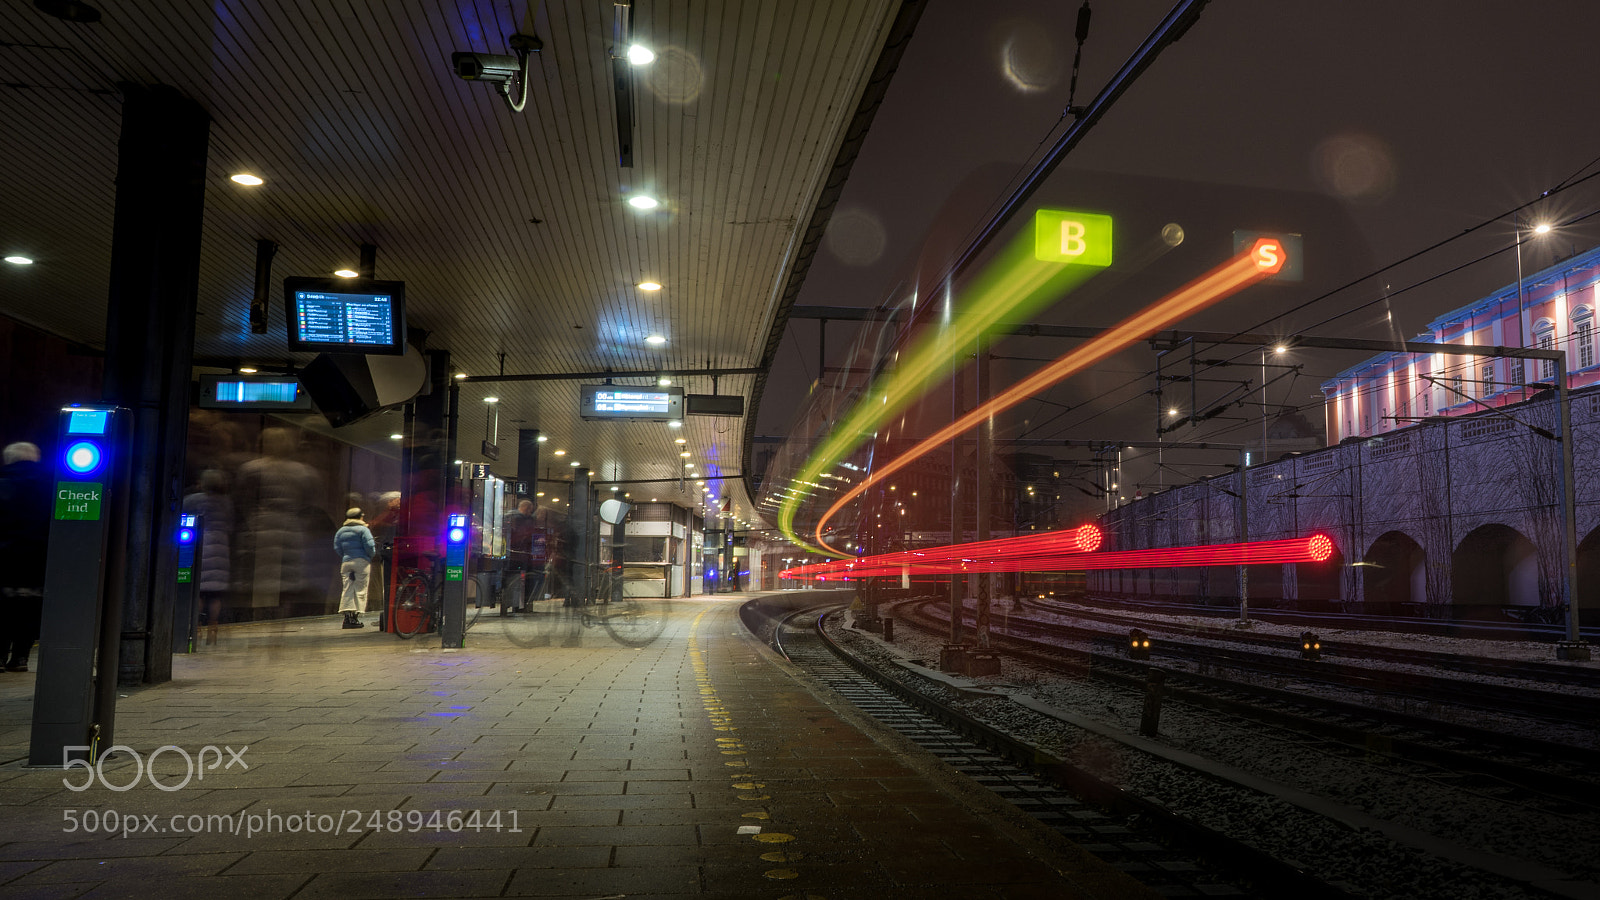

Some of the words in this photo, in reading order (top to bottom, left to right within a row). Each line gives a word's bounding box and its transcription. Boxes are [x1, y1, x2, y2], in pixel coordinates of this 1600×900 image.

[1060, 219, 1087, 256] B
[1258, 244, 1279, 267] S
[58, 489, 100, 501] Check
[67, 502, 88, 513] ind
